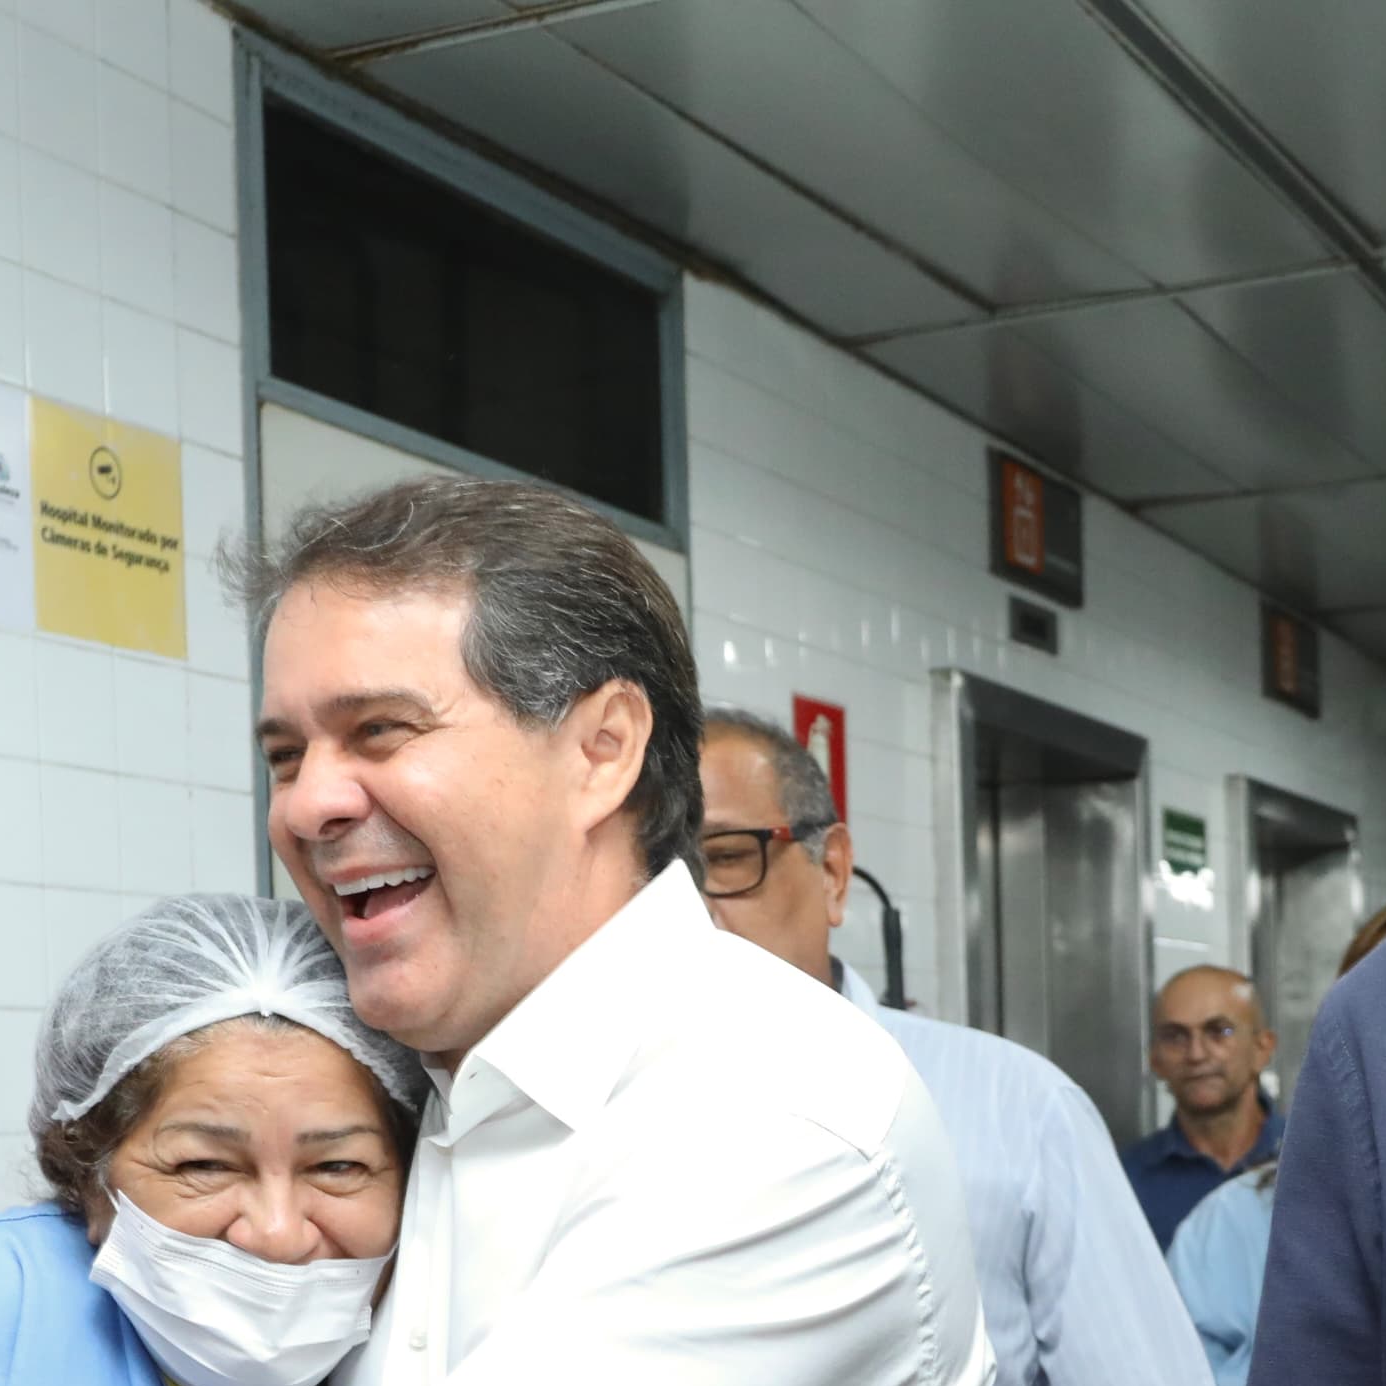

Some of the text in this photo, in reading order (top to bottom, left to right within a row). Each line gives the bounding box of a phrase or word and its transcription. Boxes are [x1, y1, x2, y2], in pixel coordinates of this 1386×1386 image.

[40, 499, 179, 551] Hospital Monitorado por
[40, 526, 91, 554] Câmeras
[94, 540, 108, 557] de
[111, 543, 170, 576] Segurança
